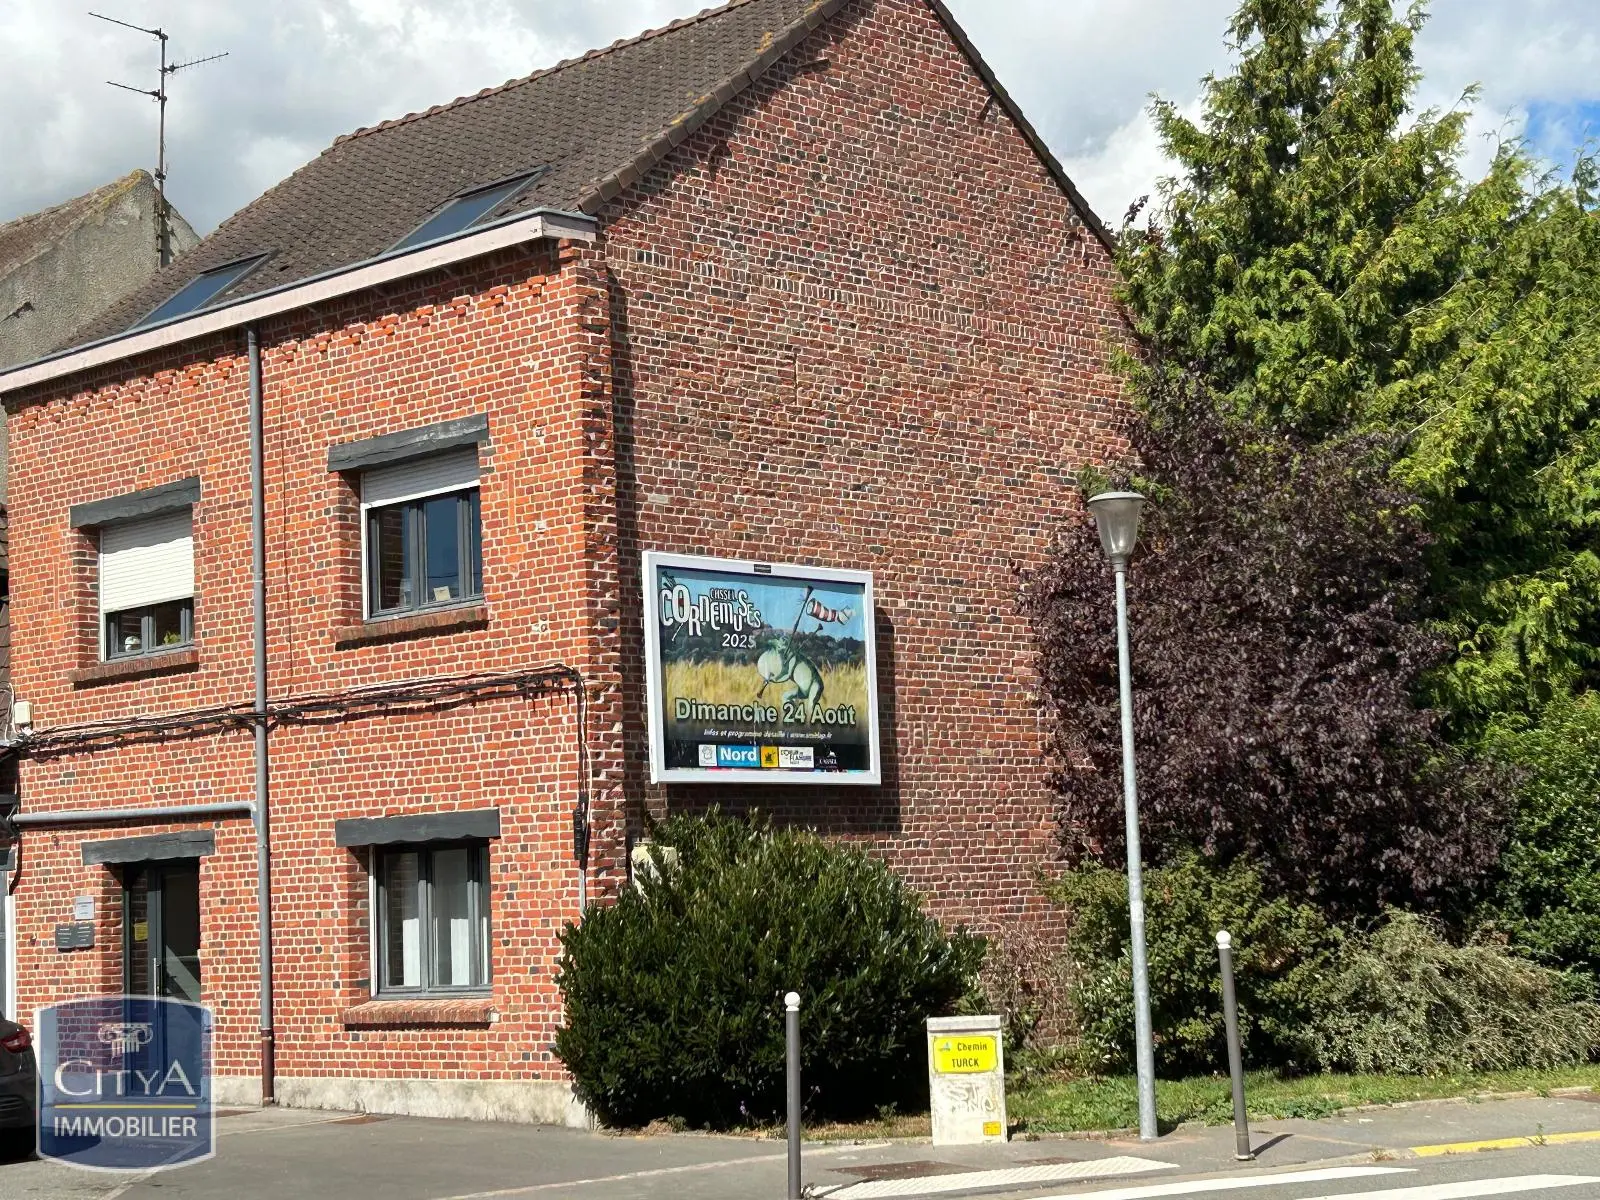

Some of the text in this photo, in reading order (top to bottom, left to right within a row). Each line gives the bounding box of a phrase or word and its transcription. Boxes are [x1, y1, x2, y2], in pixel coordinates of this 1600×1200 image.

[722, 633, 757, 648] 2025
[675, 698, 856, 725] Dimanche 24 Août
[720, 747, 757, 761] Nord
[957, 1042, 988, 1051] Chemin
[952, 1058, 980, 1068] TURCK
